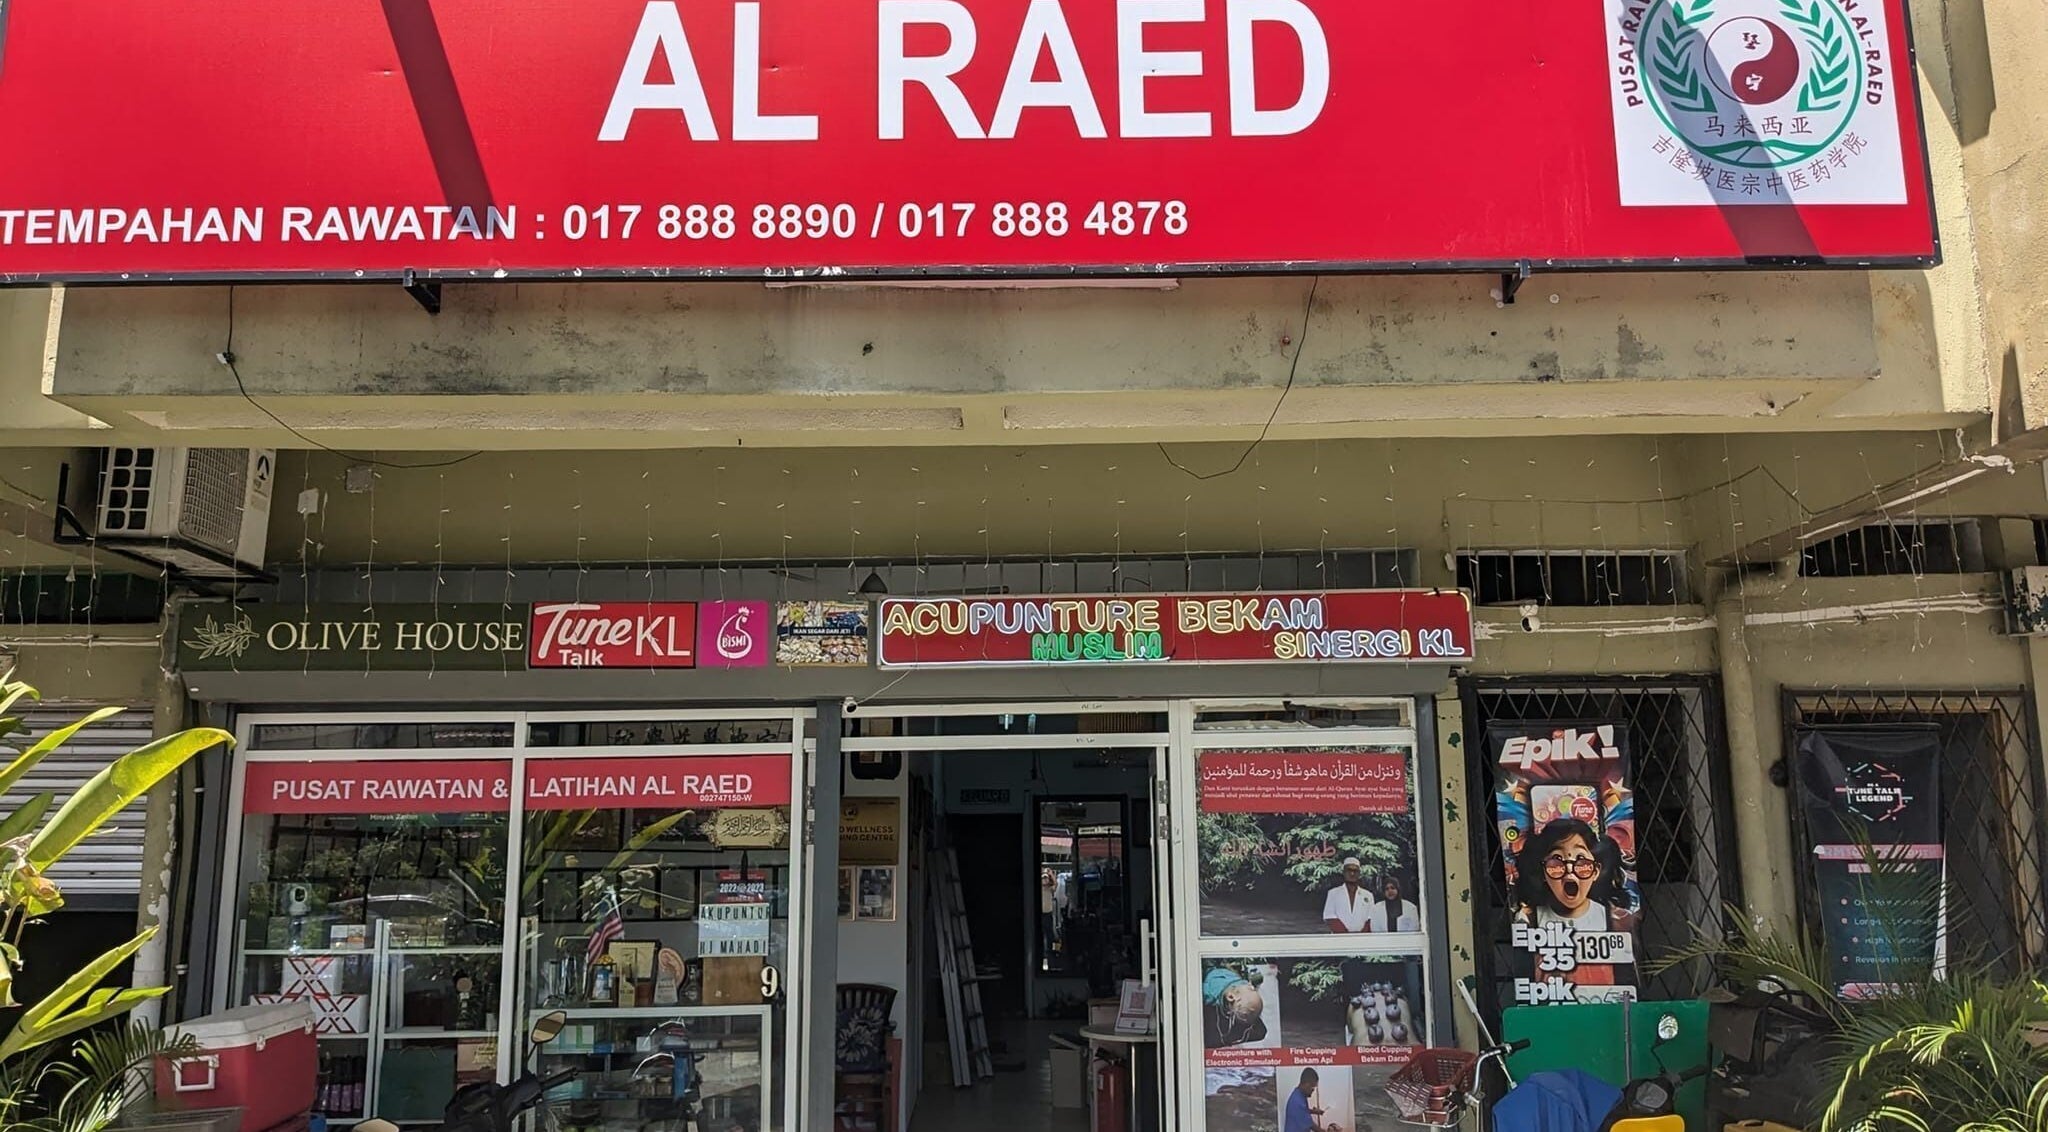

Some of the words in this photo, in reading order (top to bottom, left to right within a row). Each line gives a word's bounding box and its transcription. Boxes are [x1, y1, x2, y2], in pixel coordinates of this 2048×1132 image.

[597, 0, 819, 141] AL
[879, 0, 1331, 139] RAED
[1618, 36, 1643, 107] PUSAT
[1851, 17, 1882, 105] AL-RAED
[1704, 116, 1813, 137] 马来西亚
[1652, 132, 1867, 196] 吉隆坡医宗中医药学院
[0, 207, 264, 244] TEMPAHAN
[280, 205, 516, 242] RAWATAN
[562, 205, 641, 240] 017
[657, 204, 735, 240] 888
[752, 203, 856, 239] 8890
[870, 202, 884, 239] /
[898, 202, 976, 238] 017
[992, 201, 1069, 238] 888
[1084, 200, 1188, 237] 4878
[883, 600, 1160, 635] ACUPUNTURE
[1177, 597, 1324, 633] BEKAM
[266, 622, 381, 651] OLIVE
[394, 622, 524, 651] HOUSE
[535, 604, 632, 659] Tune
[636, 616, 690, 656] KL
[1031, 631, 1163, 661] MUSLIM
[1273, 627, 1411, 659] SINERGI
[1419, 627, 1465, 656] KL
[559, 649, 604, 666] Talk
[1499, 725, 1619, 769] Epik!
[272, 779, 355, 800] PUSAT
[362, 778, 484, 799] RAWATAN
[491, 778, 509, 799] &
[529, 776, 635, 798] LATIHAN
[642, 775, 675, 795] AL
[683, 774, 752, 795] RAED
[699, 794, 752, 802] 002747150-W
[847, 825, 894, 834] WELLNESS
[1511, 922, 1575, 952] Epik
[1577, 934, 1624, 960] 130GB
[1539, 948, 1576, 971] 35
[761, 966, 779, 998] 9
[1514, 976, 1576, 1005] Epik
[1206, 1058, 1243, 1066] Electronic
[1243, 1058, 1281, 1066] Stimulator
[1212, 1049, 1255, 1058] Acupunture
[1289, 1047, 1304, 1055] Fire
[1305, 1047, 1337, 1056] Cupping
[1294, 1056, 1320, 1064] Bekam
[1320, 1056, 1334, 1065] Api
[1357, 1046, 1380, 1054] Blood
[1381, 1045, 1413, 1054] Cupping
[1361, 1055, 1386, 1063] Bekam
[1387, 1055, 1410, 1063] Darah
